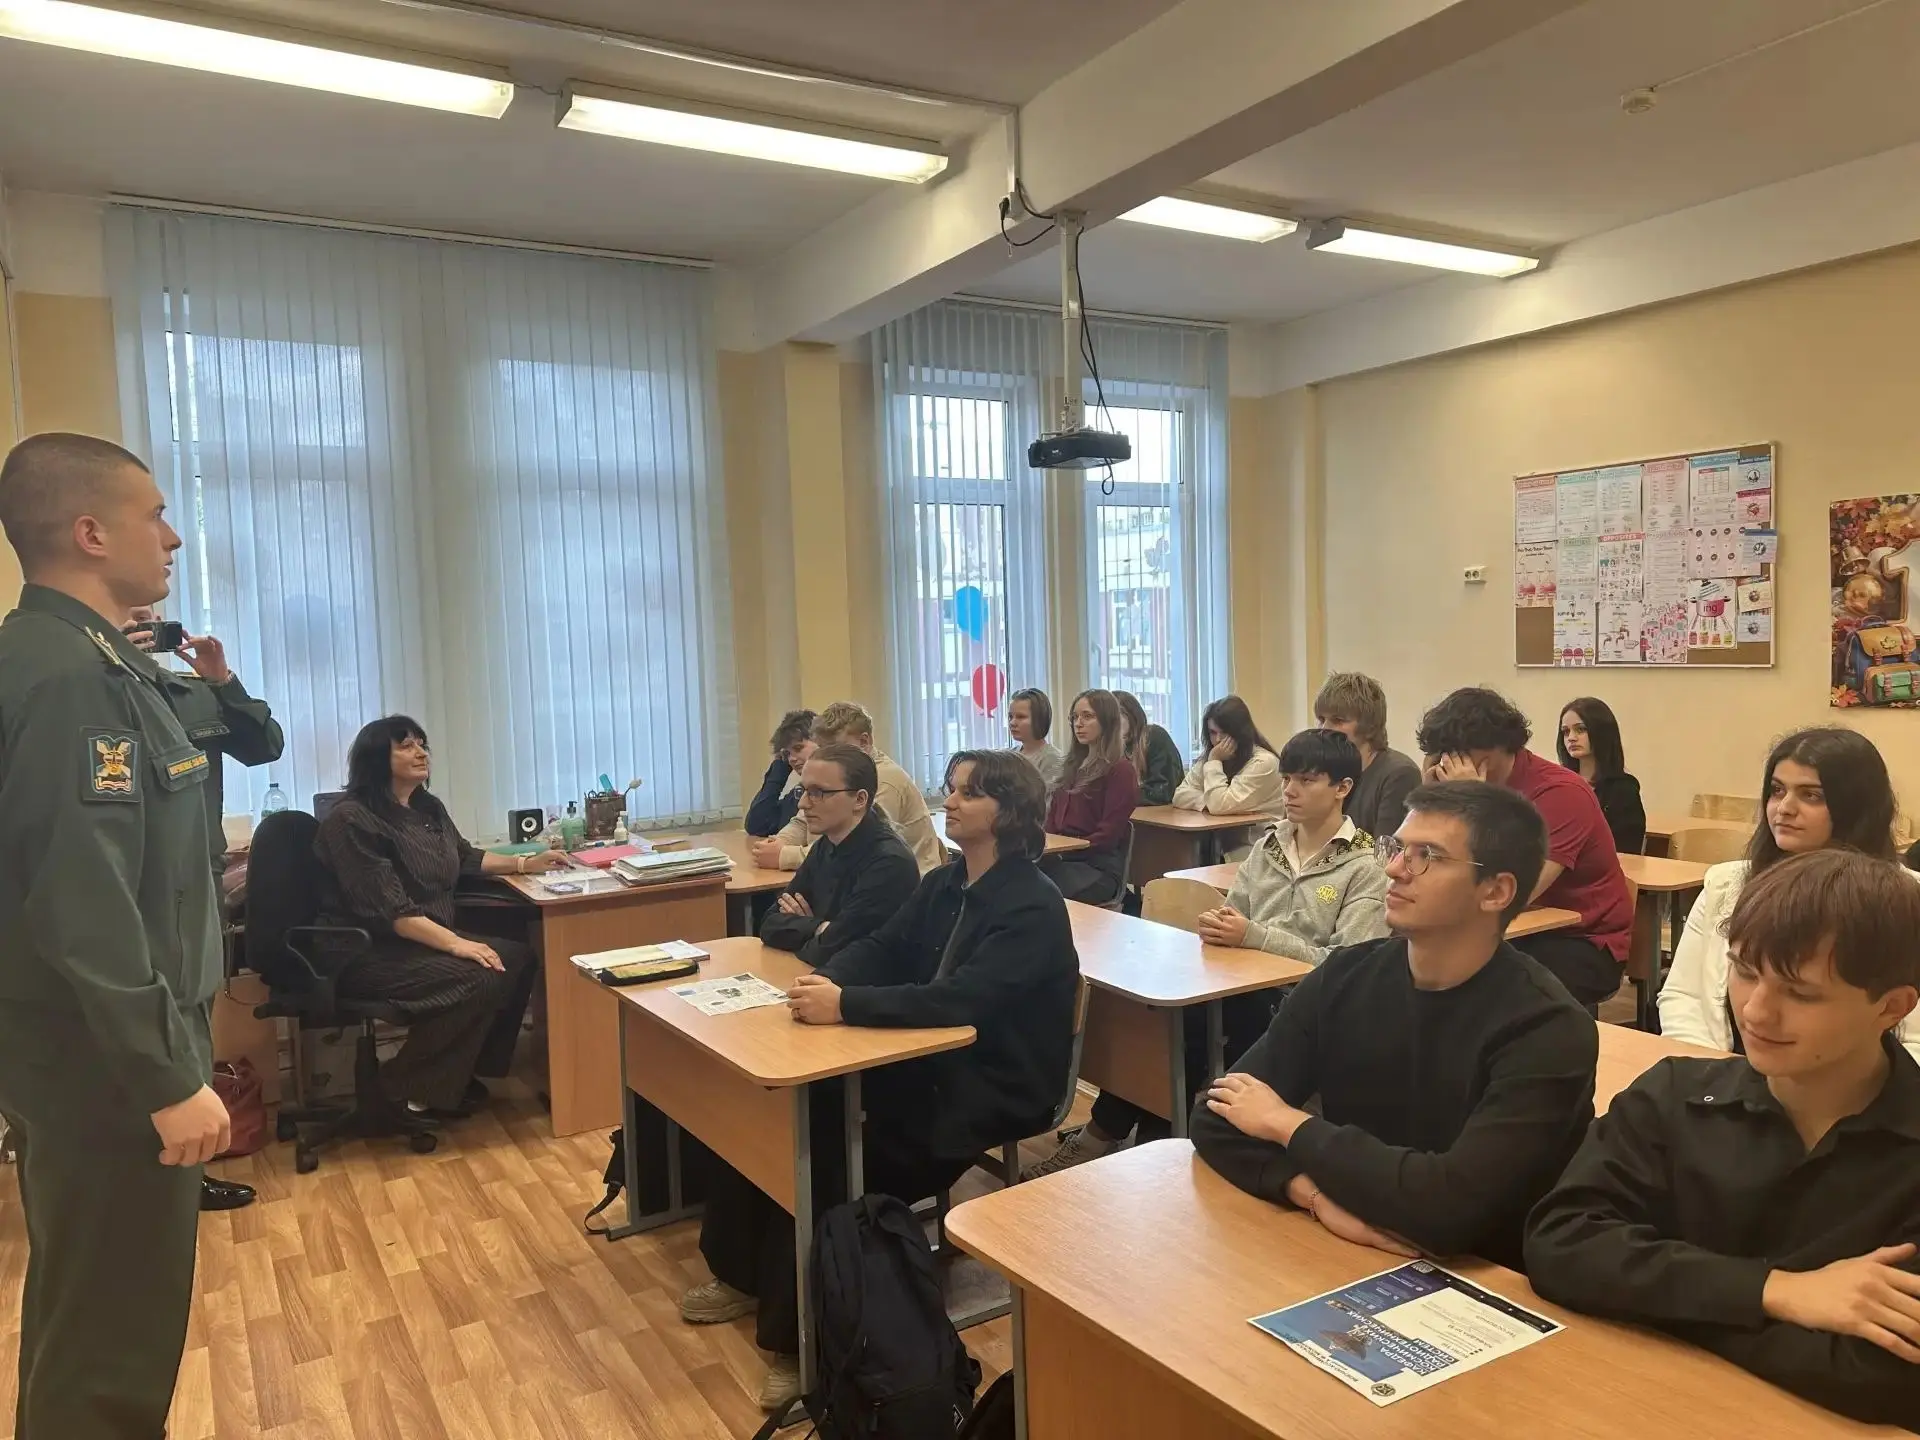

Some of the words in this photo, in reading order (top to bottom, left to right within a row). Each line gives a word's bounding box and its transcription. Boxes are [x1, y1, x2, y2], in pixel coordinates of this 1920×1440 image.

[1603, 532, 1637, 541] OPPOSITES
[1703, 604, 1718, 614] ing
[1346, 1310, 1446, 1368] РАДИОТЕХНИЧЕСКИХ
[1364, 1326, 1437, 1371] КОСМИЧЕСКИХ
[1412, 1338, 1455, 1364] СИСТЕМ
[1380, 1346, 1428, 1375] КАФЕДРА
